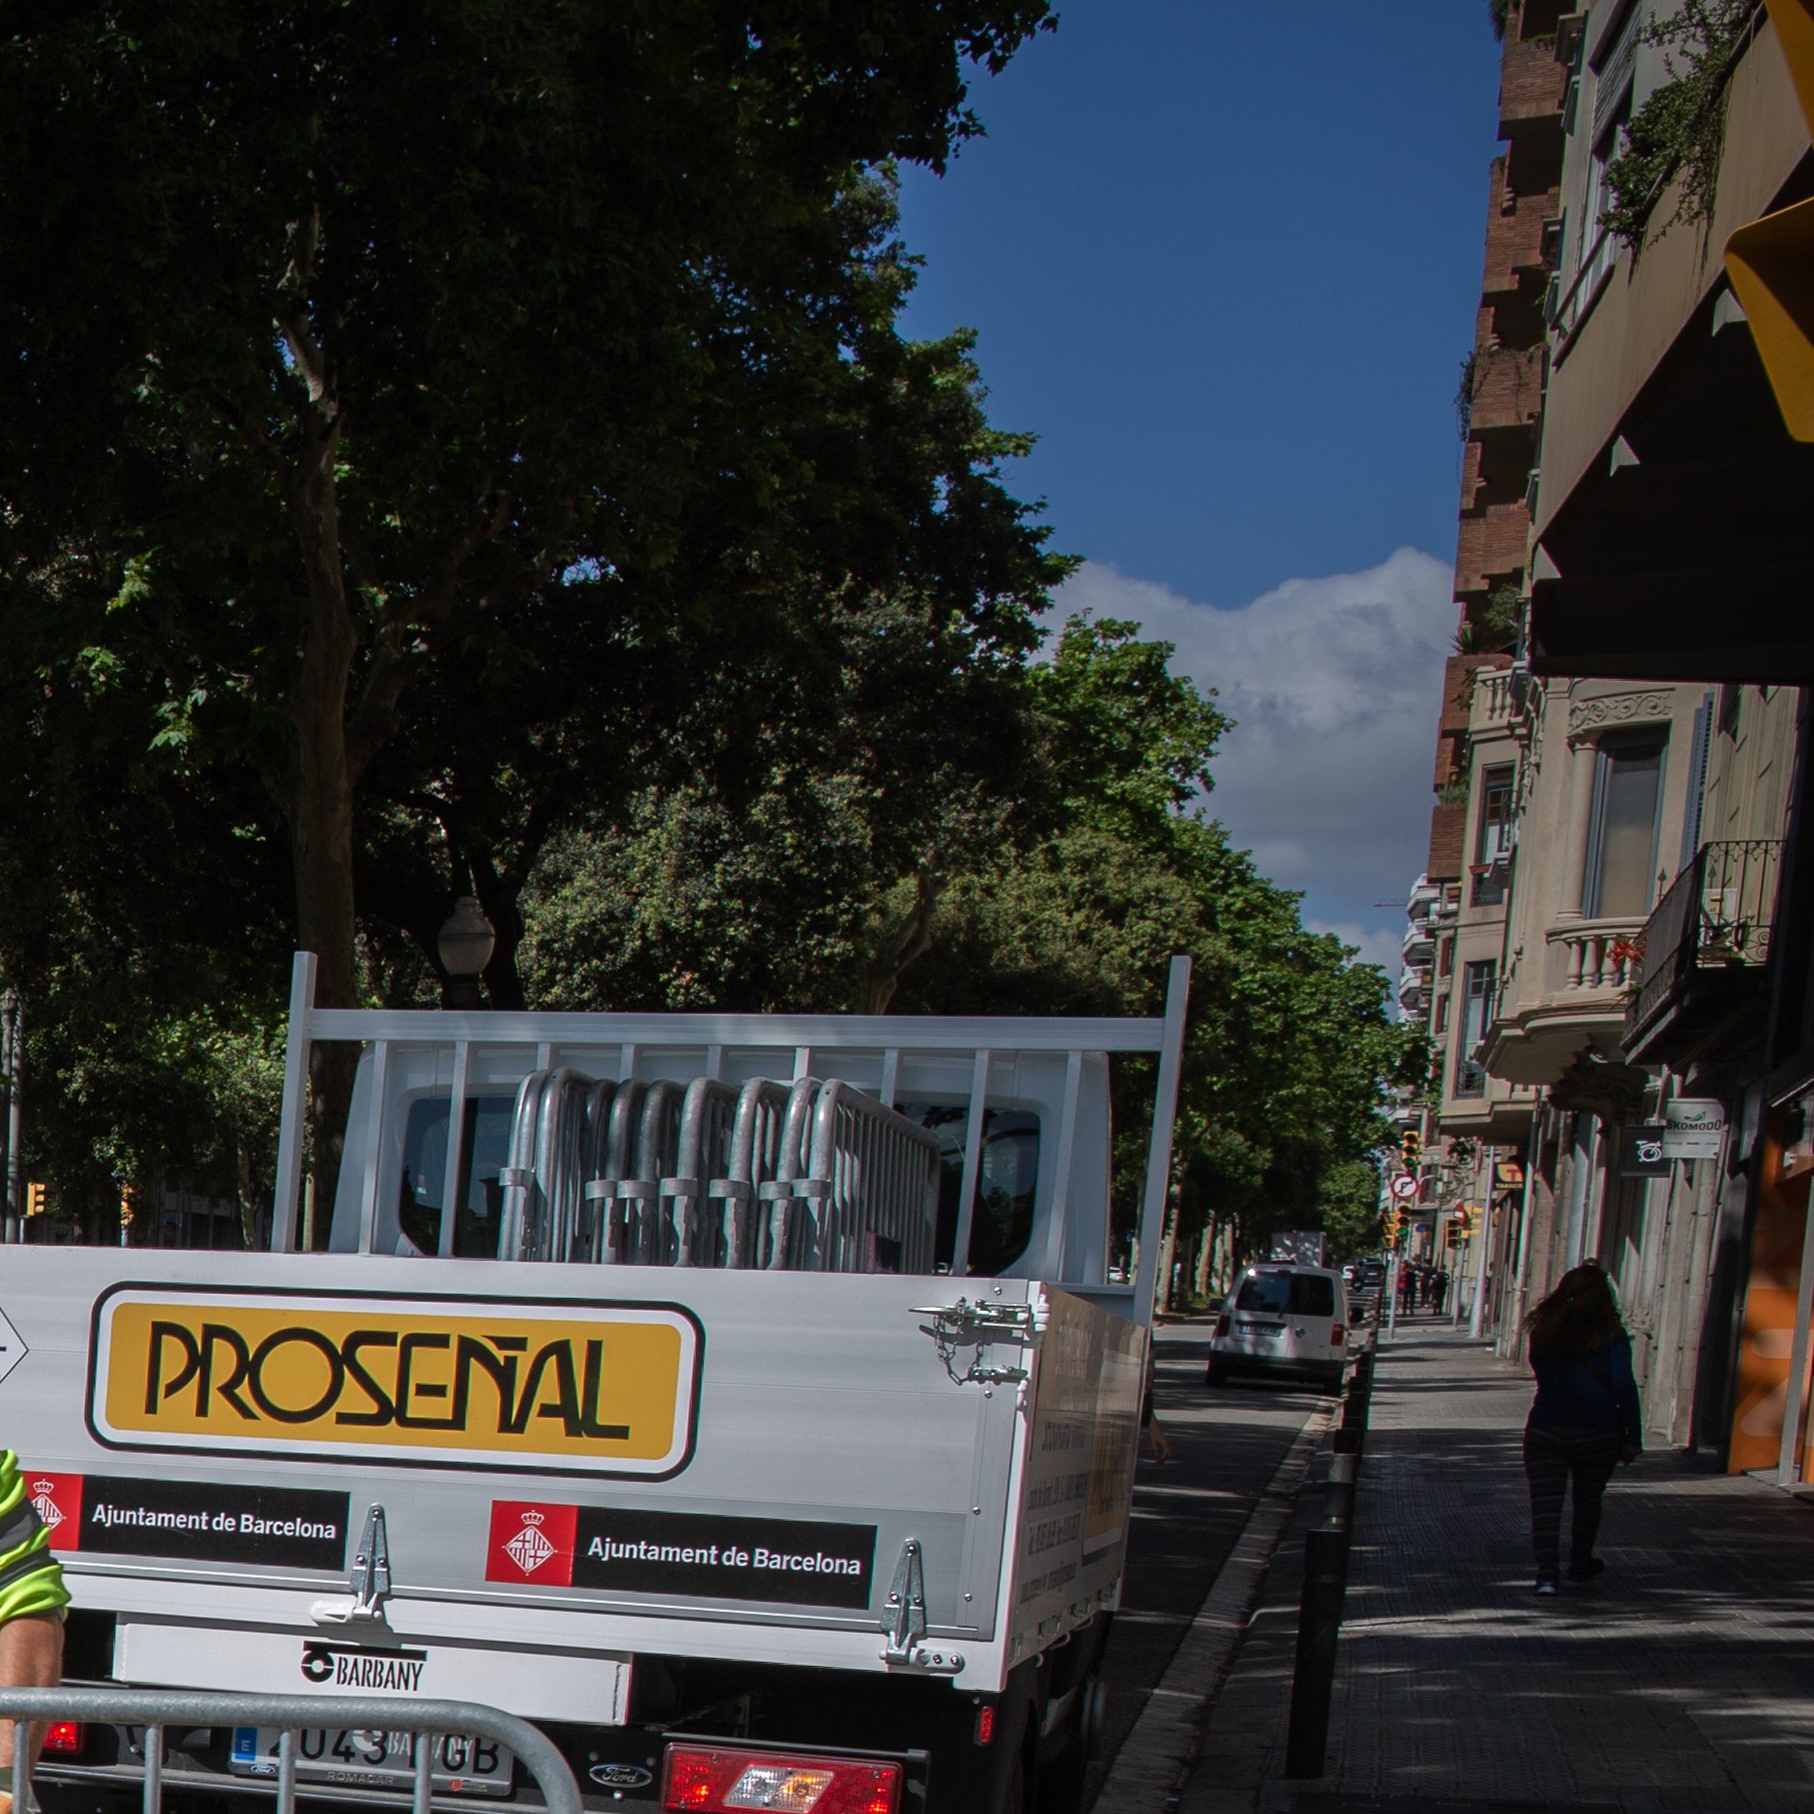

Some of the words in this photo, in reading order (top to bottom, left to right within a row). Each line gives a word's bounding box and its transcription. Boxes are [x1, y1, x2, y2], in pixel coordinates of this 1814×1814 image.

[144, 1319, 630, 1440] PROSEÑAL
[92, 1503, 209, 1531] Ajuntament
[212, 1509, 236, 1531] de
[240, 1512, 337, 1540] Barcelona
[586, 1536, 717, 1569] Ajuntament
[722, 1544, 750, 1567] de
[754, 1547, 862, 1577] Barcelona
[335, 1655, 425, 1692] BARBANY
[326, 1770, 395, 1785] ROMACAR
[601, 1767, 640, 1783] Ford
